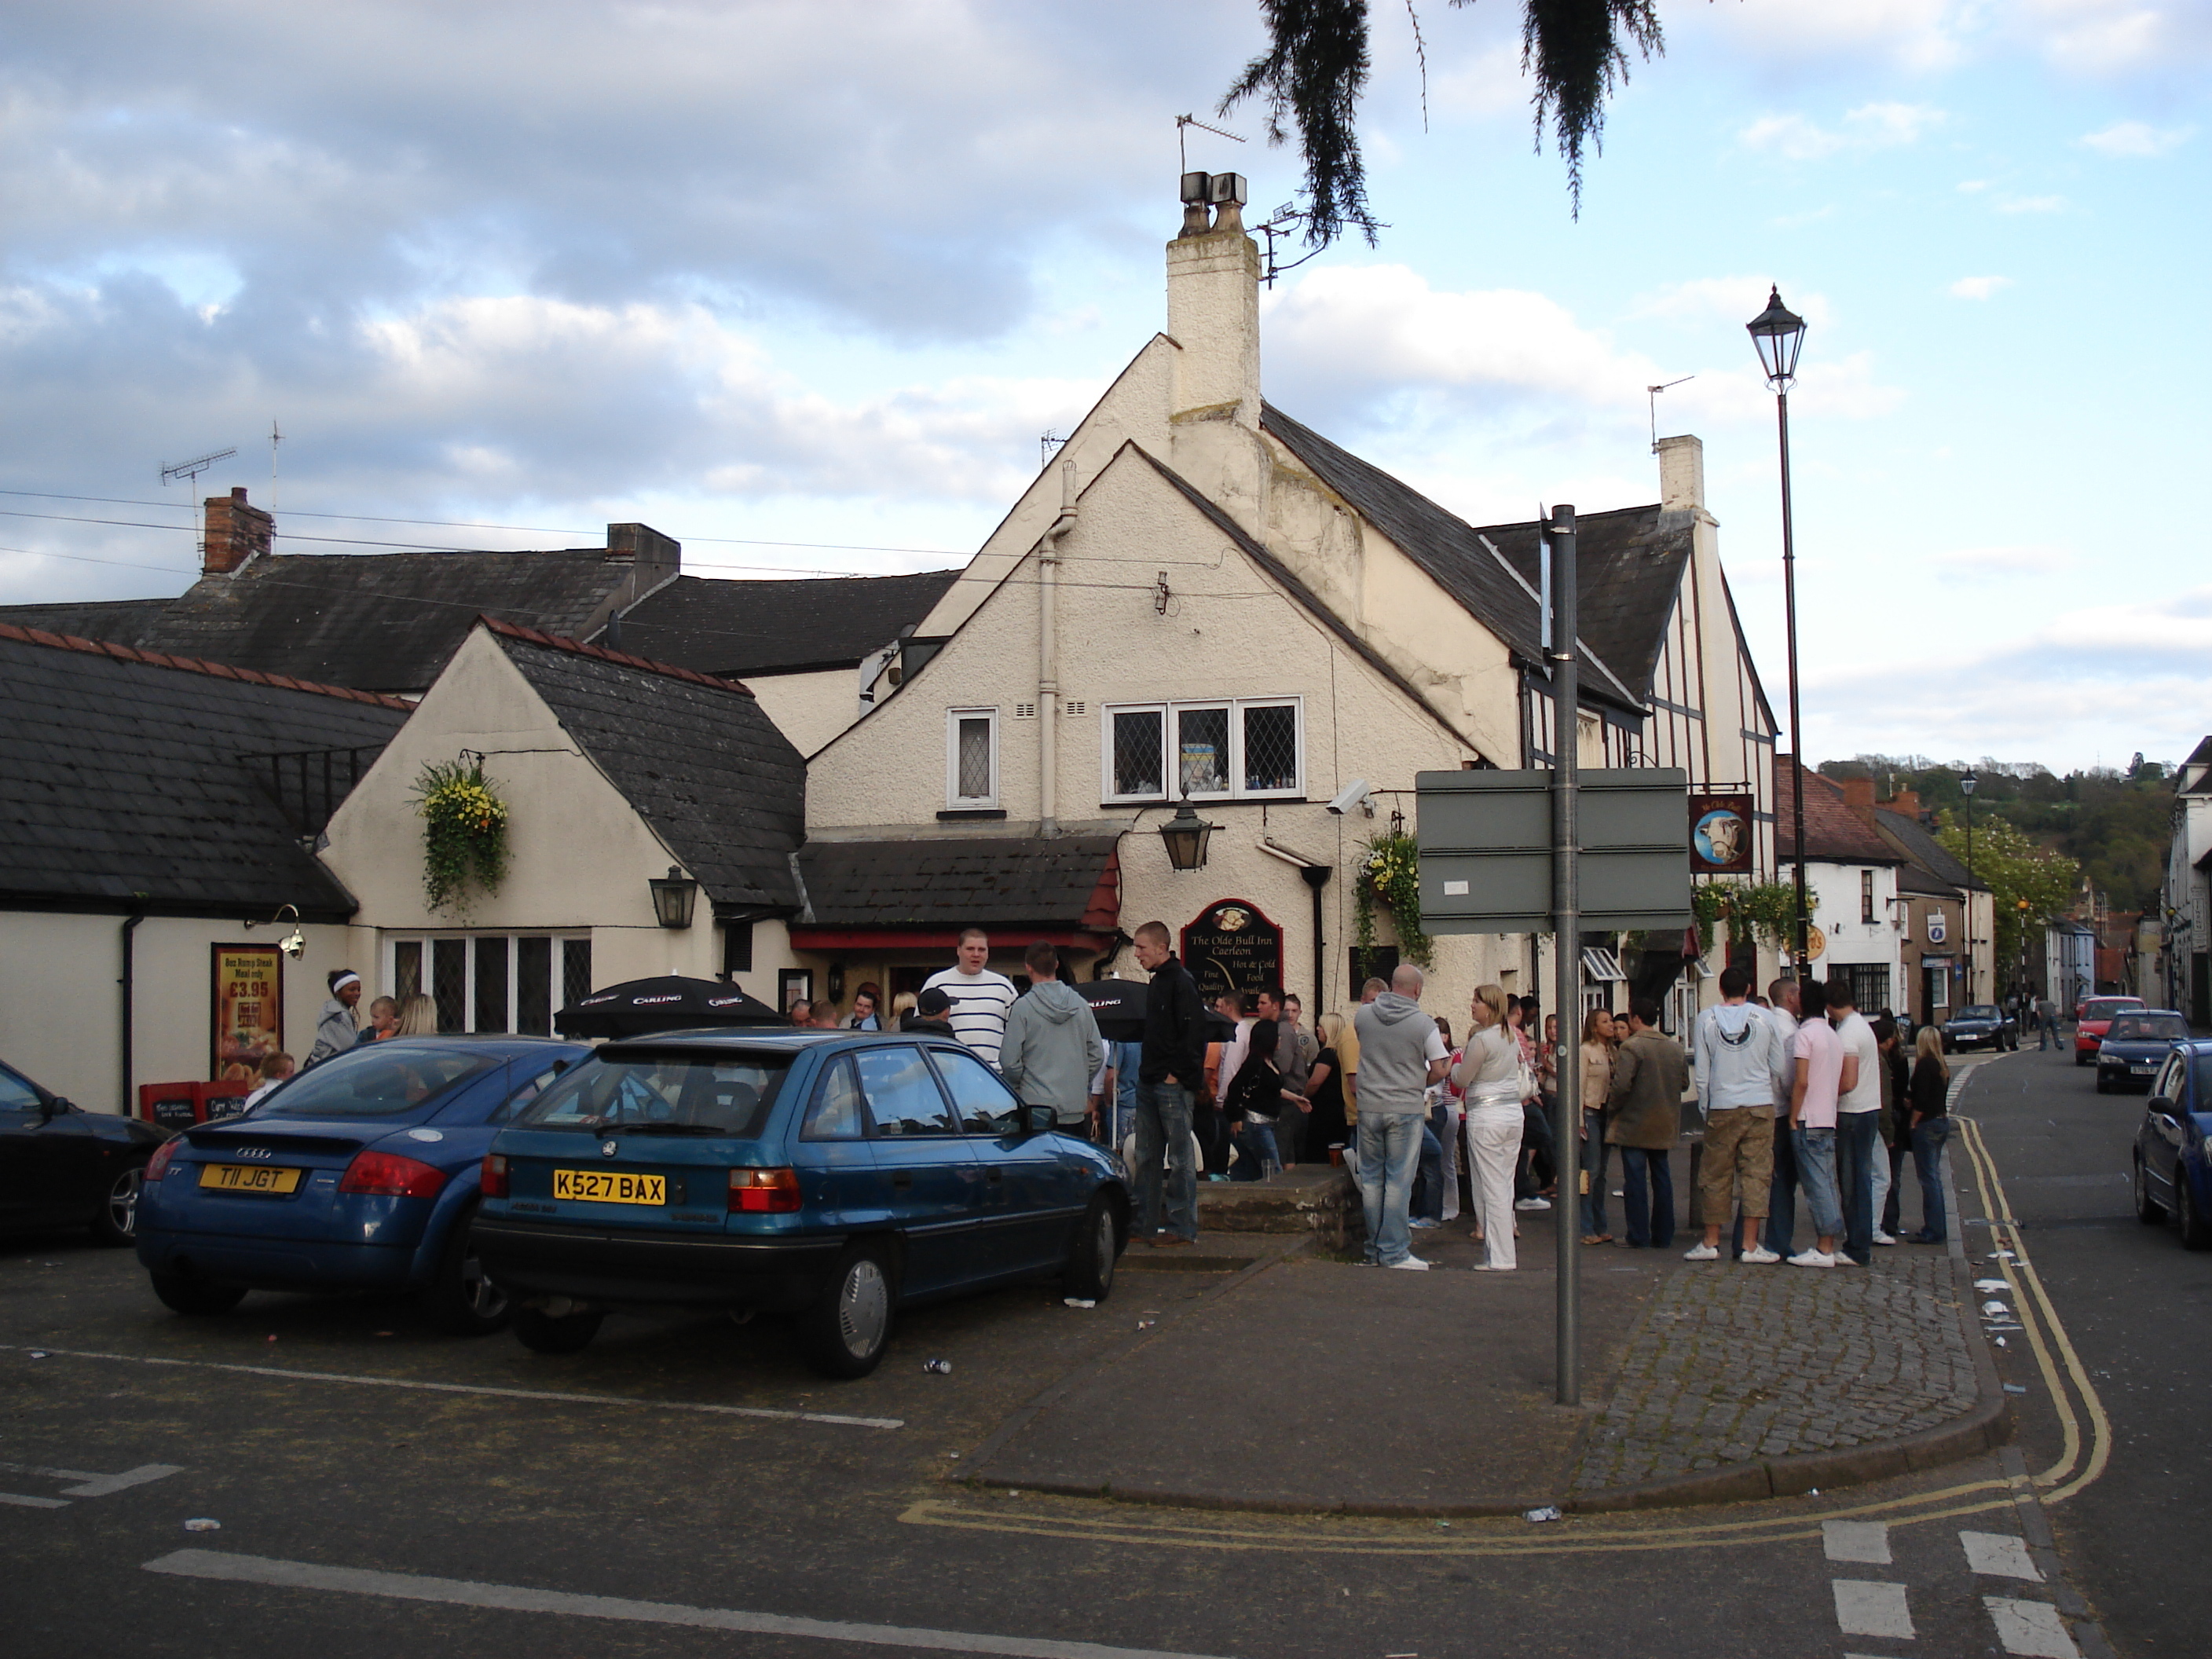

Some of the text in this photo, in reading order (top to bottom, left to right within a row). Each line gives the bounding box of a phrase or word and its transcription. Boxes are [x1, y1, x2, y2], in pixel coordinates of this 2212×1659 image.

[1192, 935, 1273, 945] The Olde Bull Inn
[1212, 946, 1251, 955] Caerleon
[238, 958, 255, 969] Rump
[257, 958, 273, 967] Steak
[1258, 959, 1276, 969] Cold
[235, 969, 250, 978] Meal
[230, 981, 269, 998] £3.95
[1198, 983, 1225, 994] Quality
[632, 994, 682, 1005] CARLING
[1088, 998, 1122, 1008] RLING
[243, 1170, 283, 1188] JGT
[558, 1174, 662, 1200] K527 BAX
